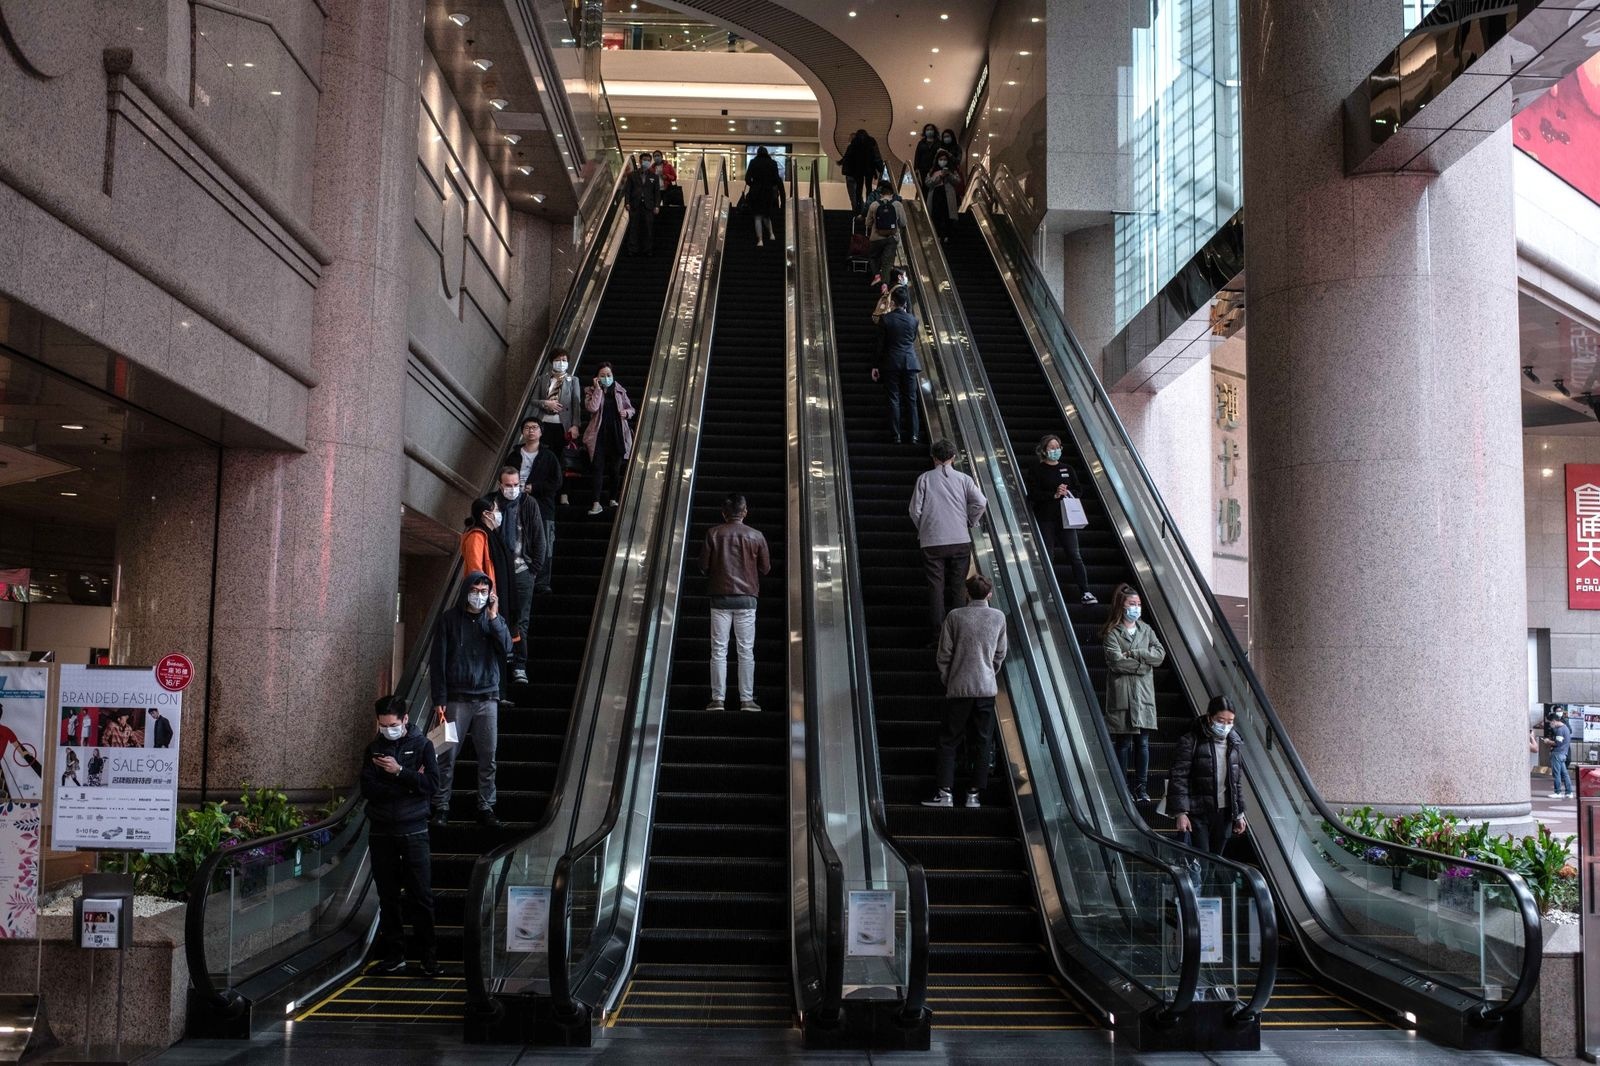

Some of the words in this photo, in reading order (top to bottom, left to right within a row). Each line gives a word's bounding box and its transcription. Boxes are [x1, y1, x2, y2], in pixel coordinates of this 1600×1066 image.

[1573, 483, 1600, 568] 食通天
[165, 679, 180, 687] 16/F
[62, 691, 119, 704] BRANDED
[123, 692, 178, 705] FASHION
[112, 759, 144, 772] SALE
[146, 759, 173, 772] 90%
